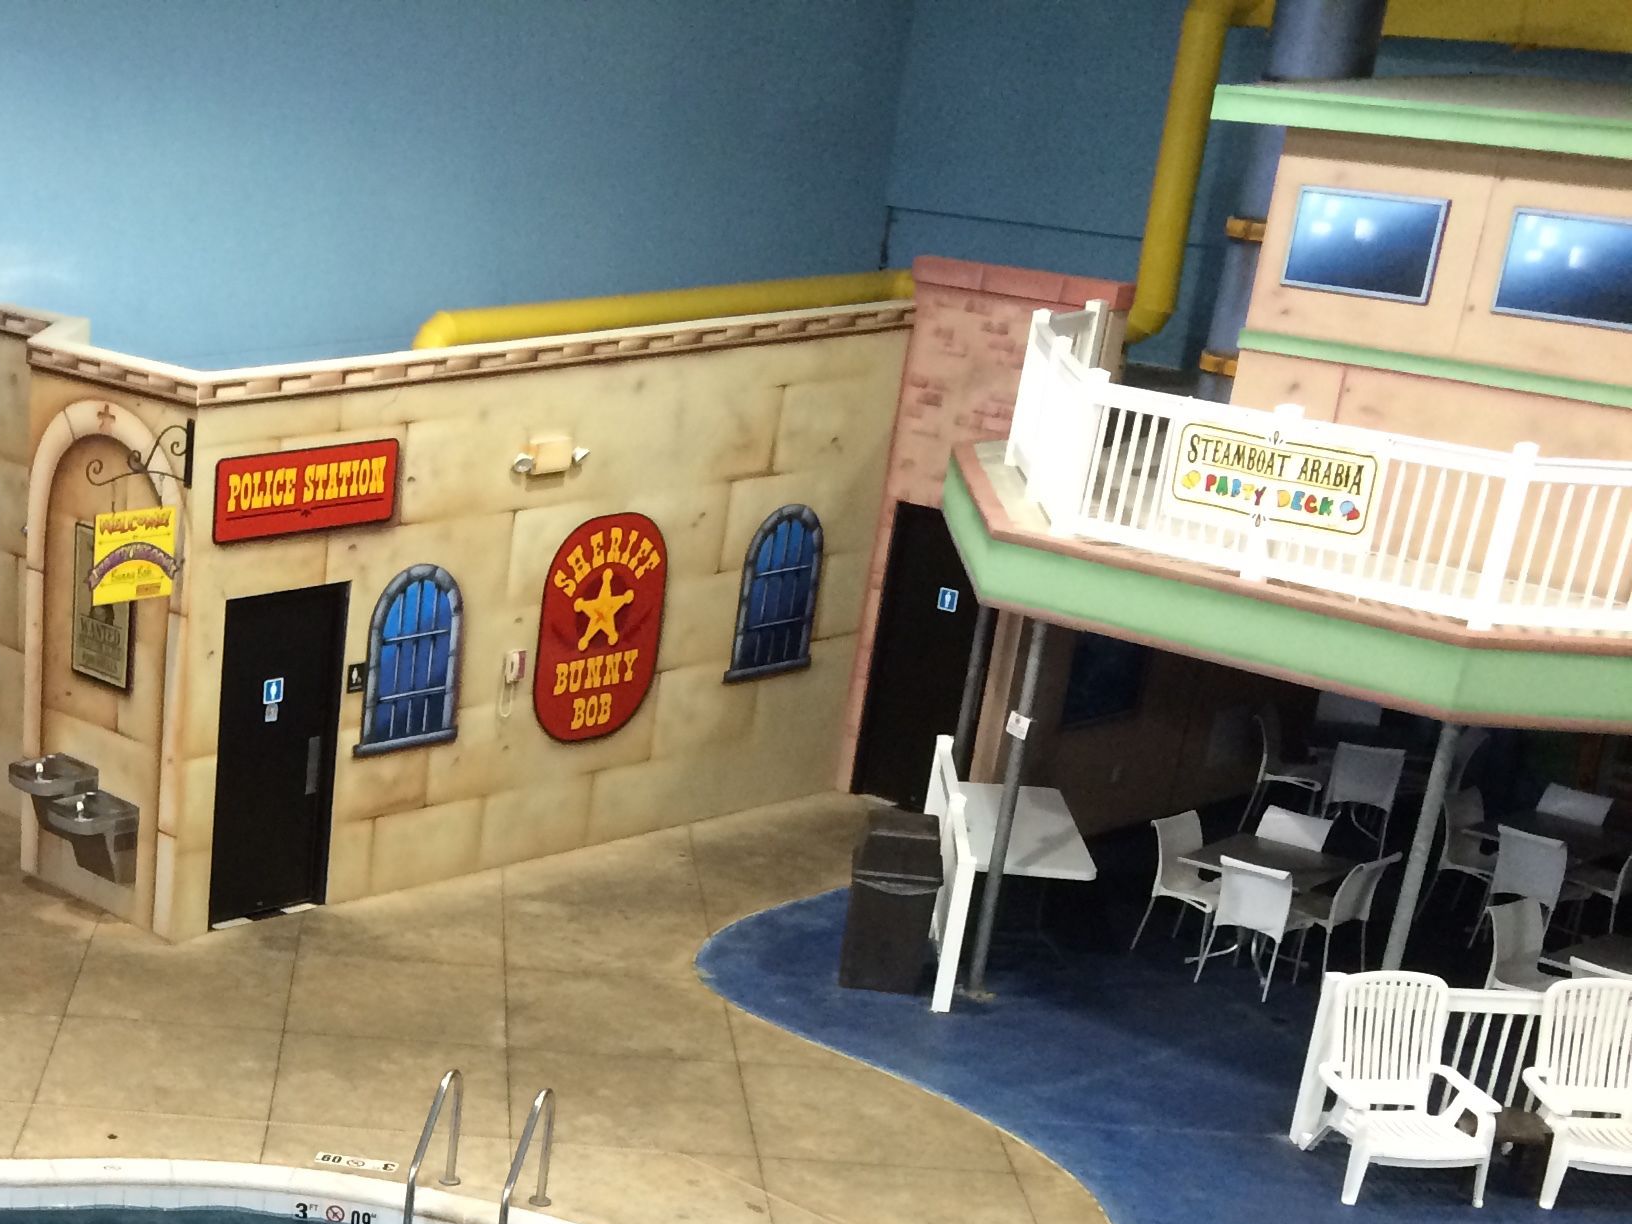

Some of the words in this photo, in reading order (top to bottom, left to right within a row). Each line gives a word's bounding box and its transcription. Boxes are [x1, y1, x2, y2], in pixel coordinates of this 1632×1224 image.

[226, 467, 298, 513] POLICE
[302, 455, 387, 504] STATION
[1187, 433, 1291, 478] STEAMBOAT
[1297, 457, 1365, 496] ARABIA
[1204, 473, 1267, 506] PARTY
[1276, 489, 1334, 517] DECK
[553, 526, 661, 598] SHERIFF
[552, 648, 639, 696] BUNNY
[570, 692, 612, 731] BOB
[294, 1202, 308, 1219] 3
